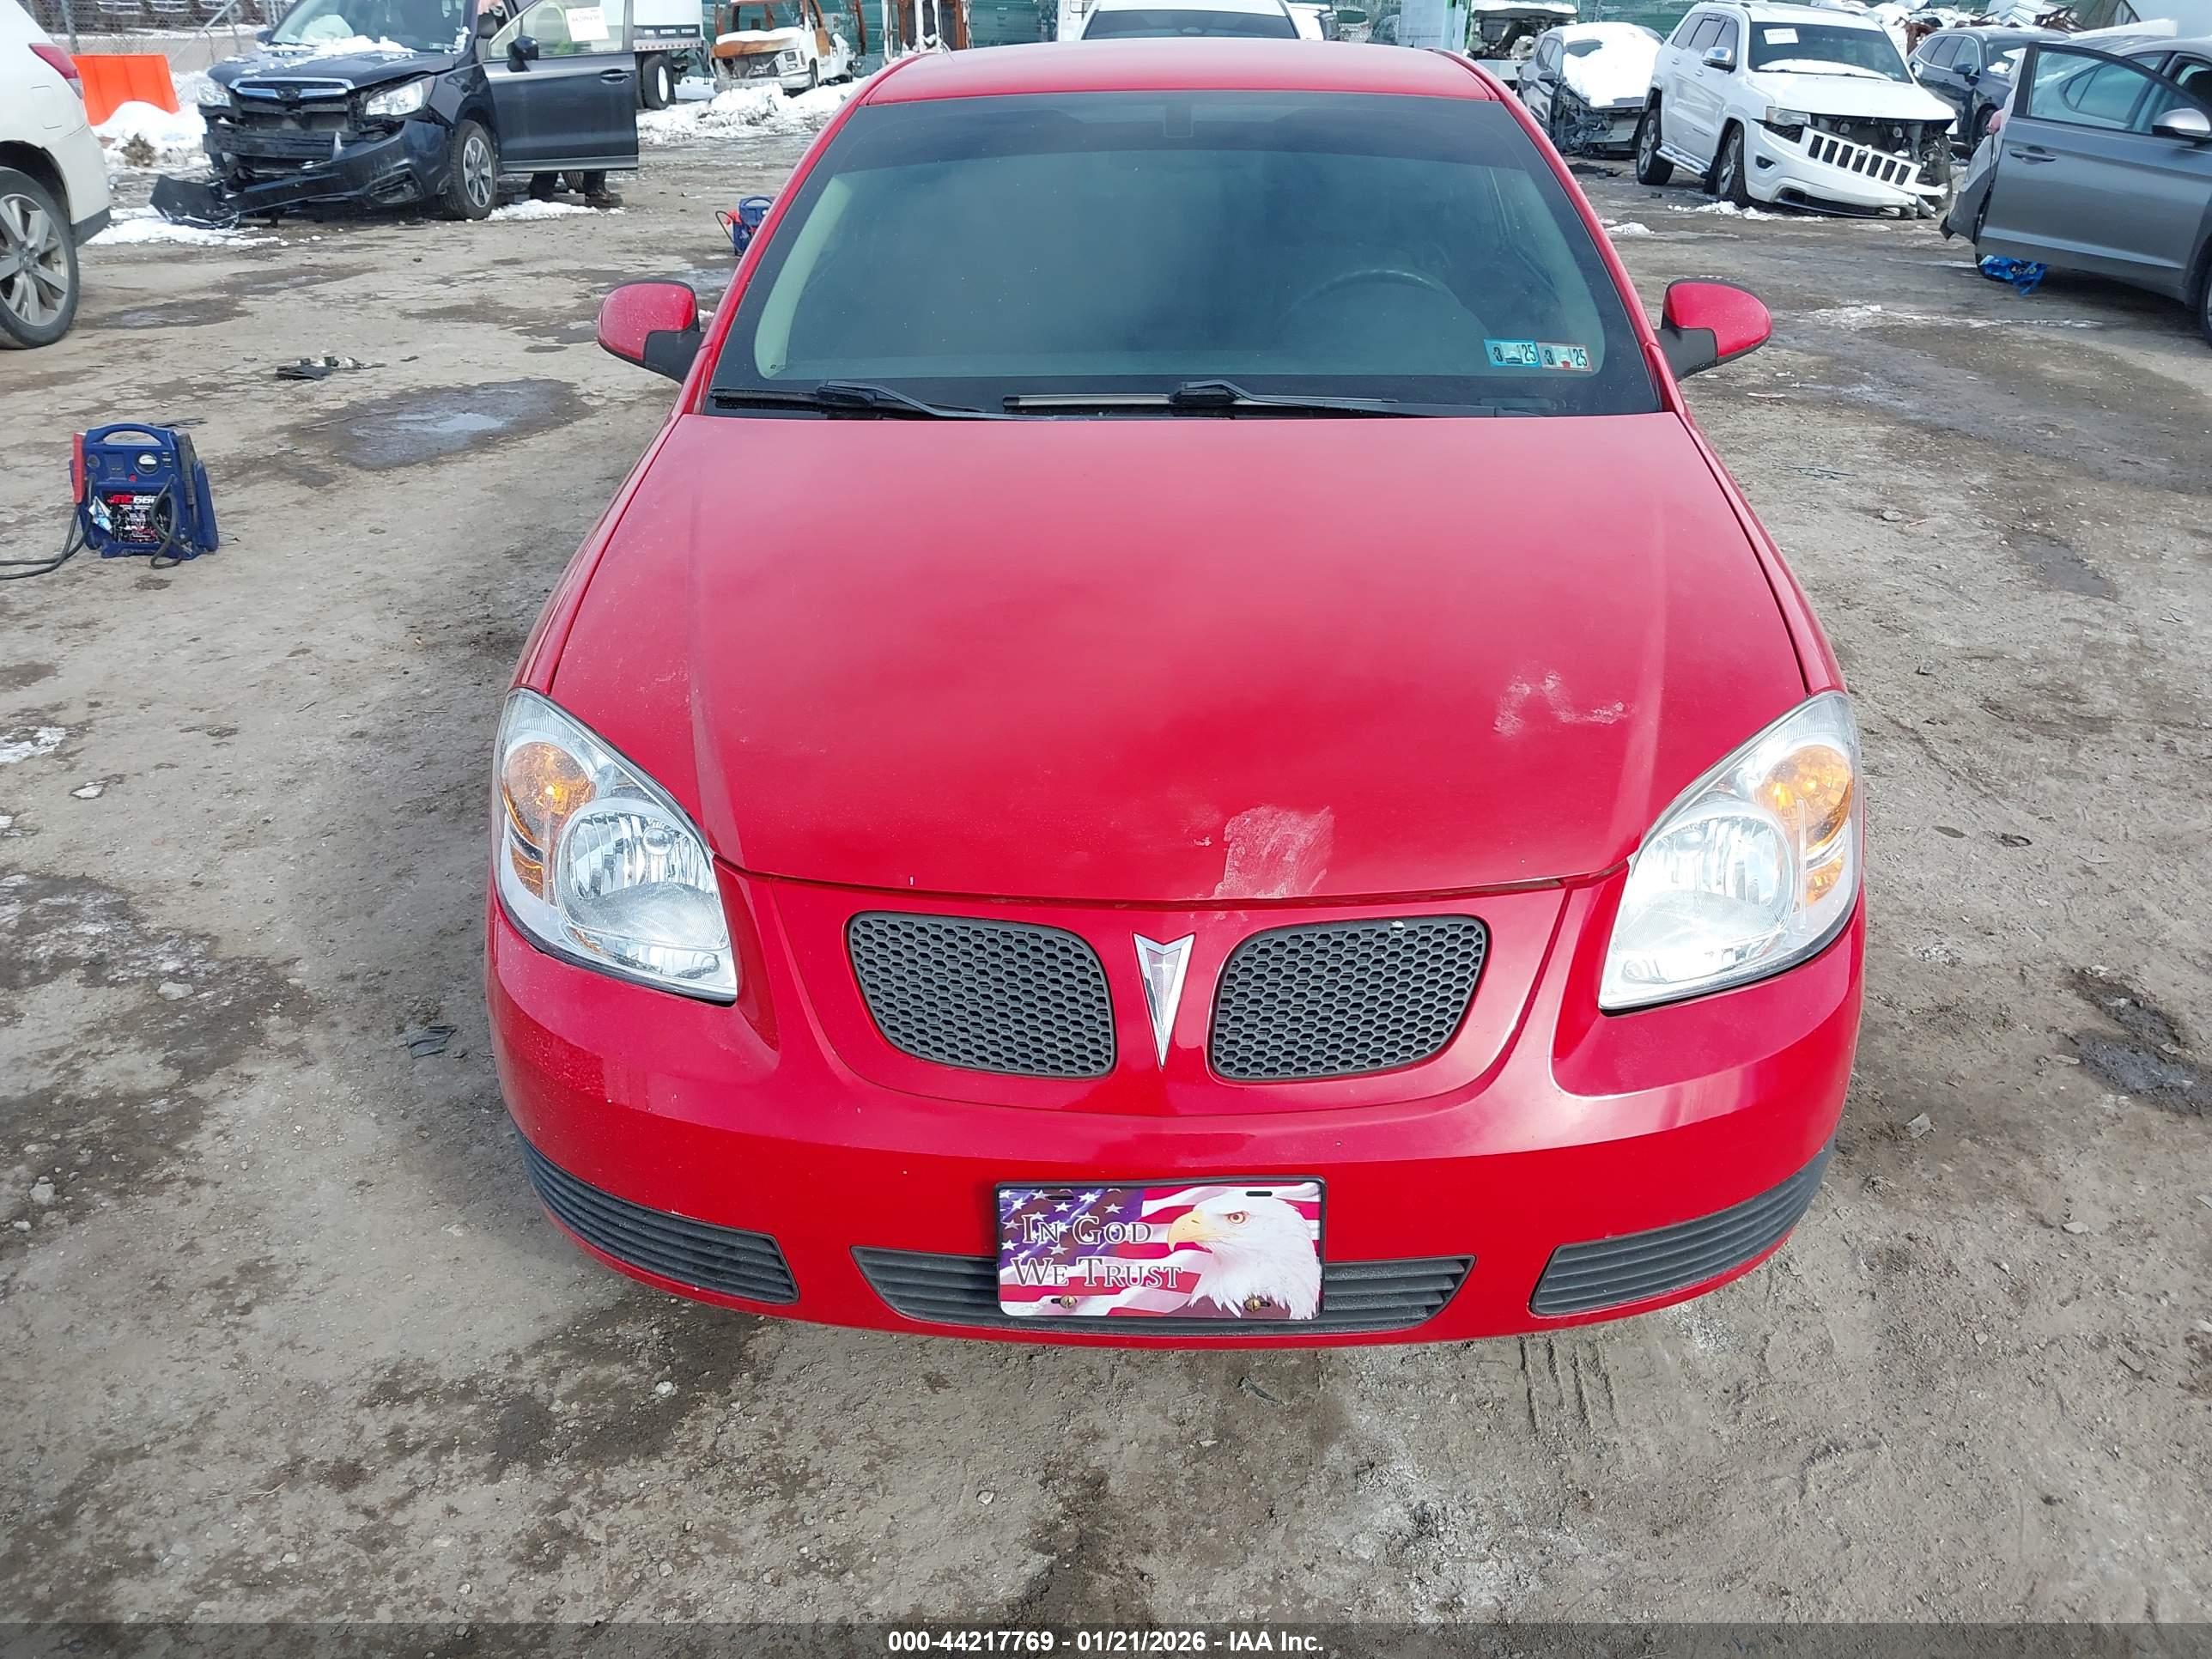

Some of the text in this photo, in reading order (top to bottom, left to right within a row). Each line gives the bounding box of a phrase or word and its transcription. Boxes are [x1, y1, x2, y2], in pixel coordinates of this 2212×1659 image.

[1522, 344, 1537, 362] 25
[1572, 349, 1588, 367] 25
[1023, 1215, 1152, 1243] IN GOD
[1012, 1257, 1182, 1287] WE TRUST
